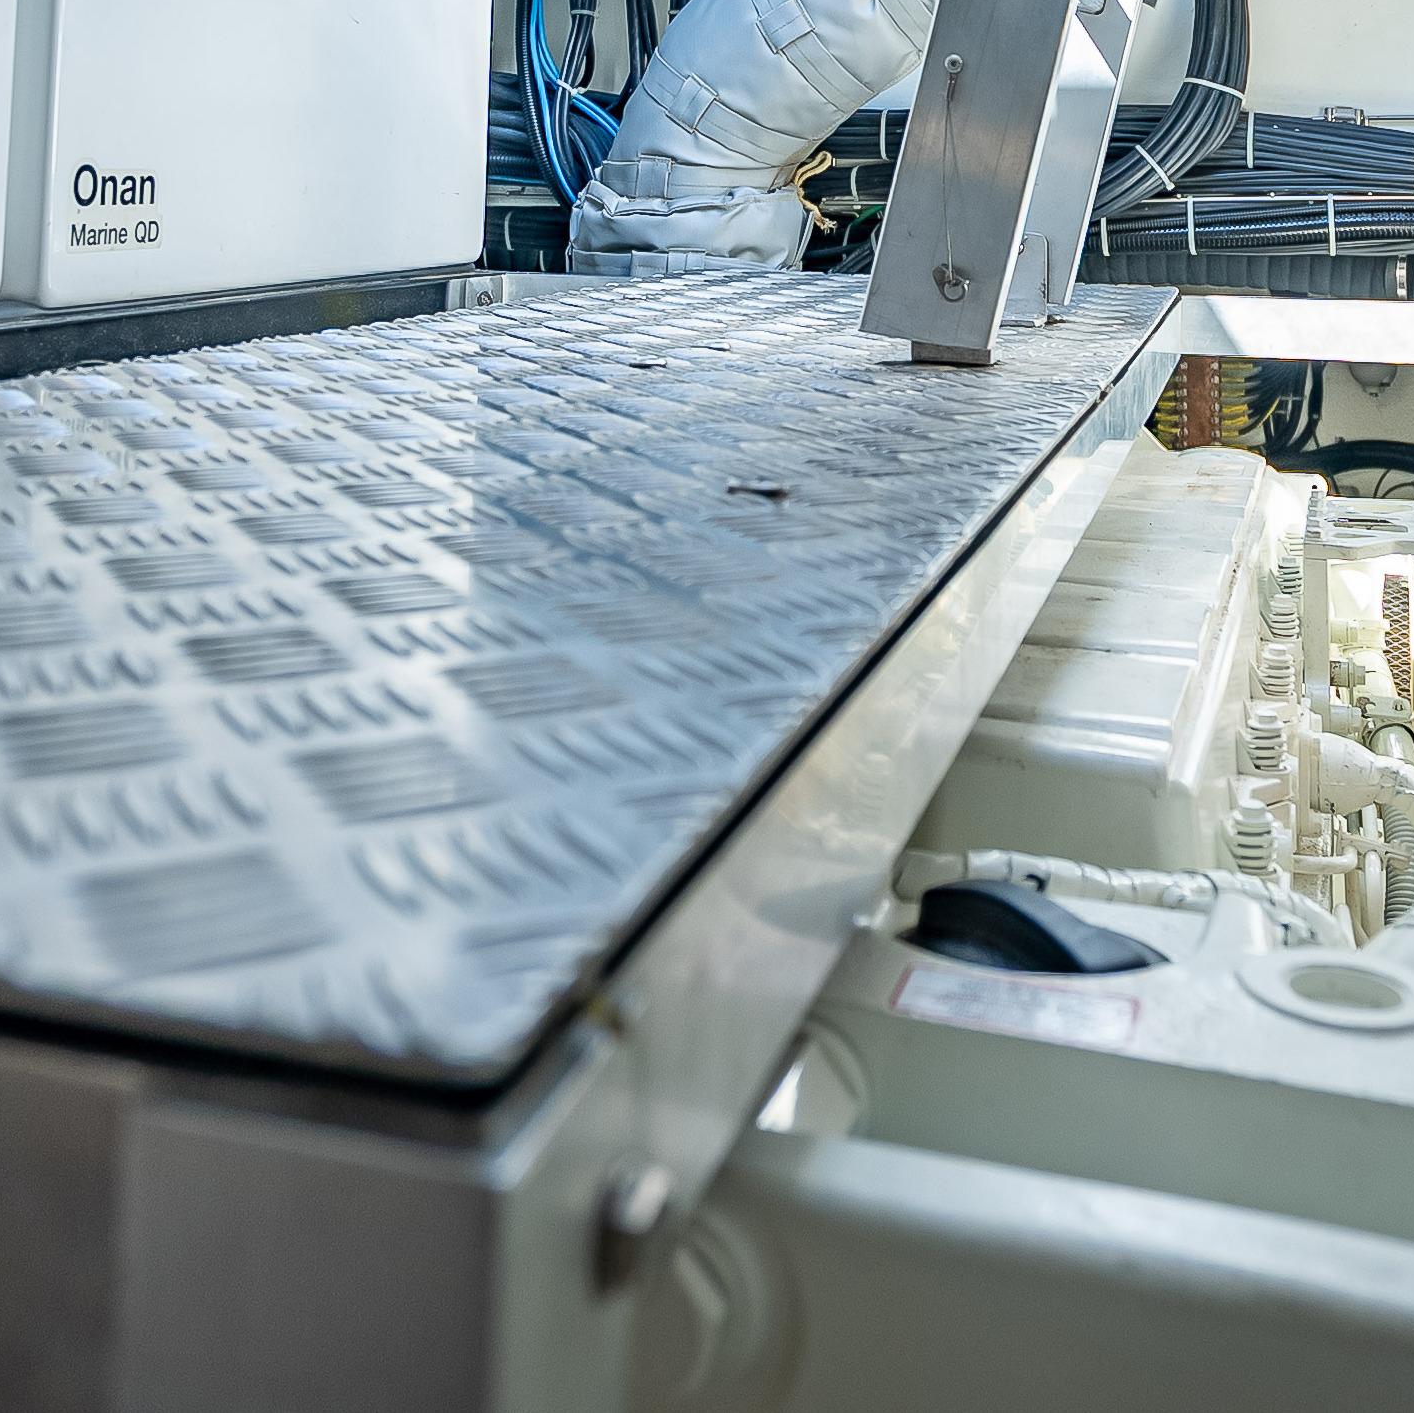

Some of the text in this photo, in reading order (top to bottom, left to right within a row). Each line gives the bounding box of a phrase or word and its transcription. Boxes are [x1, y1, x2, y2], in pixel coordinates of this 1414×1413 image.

[74, 164, 156, 207] Onan
[70, 220, 160, 247] Marine QD
